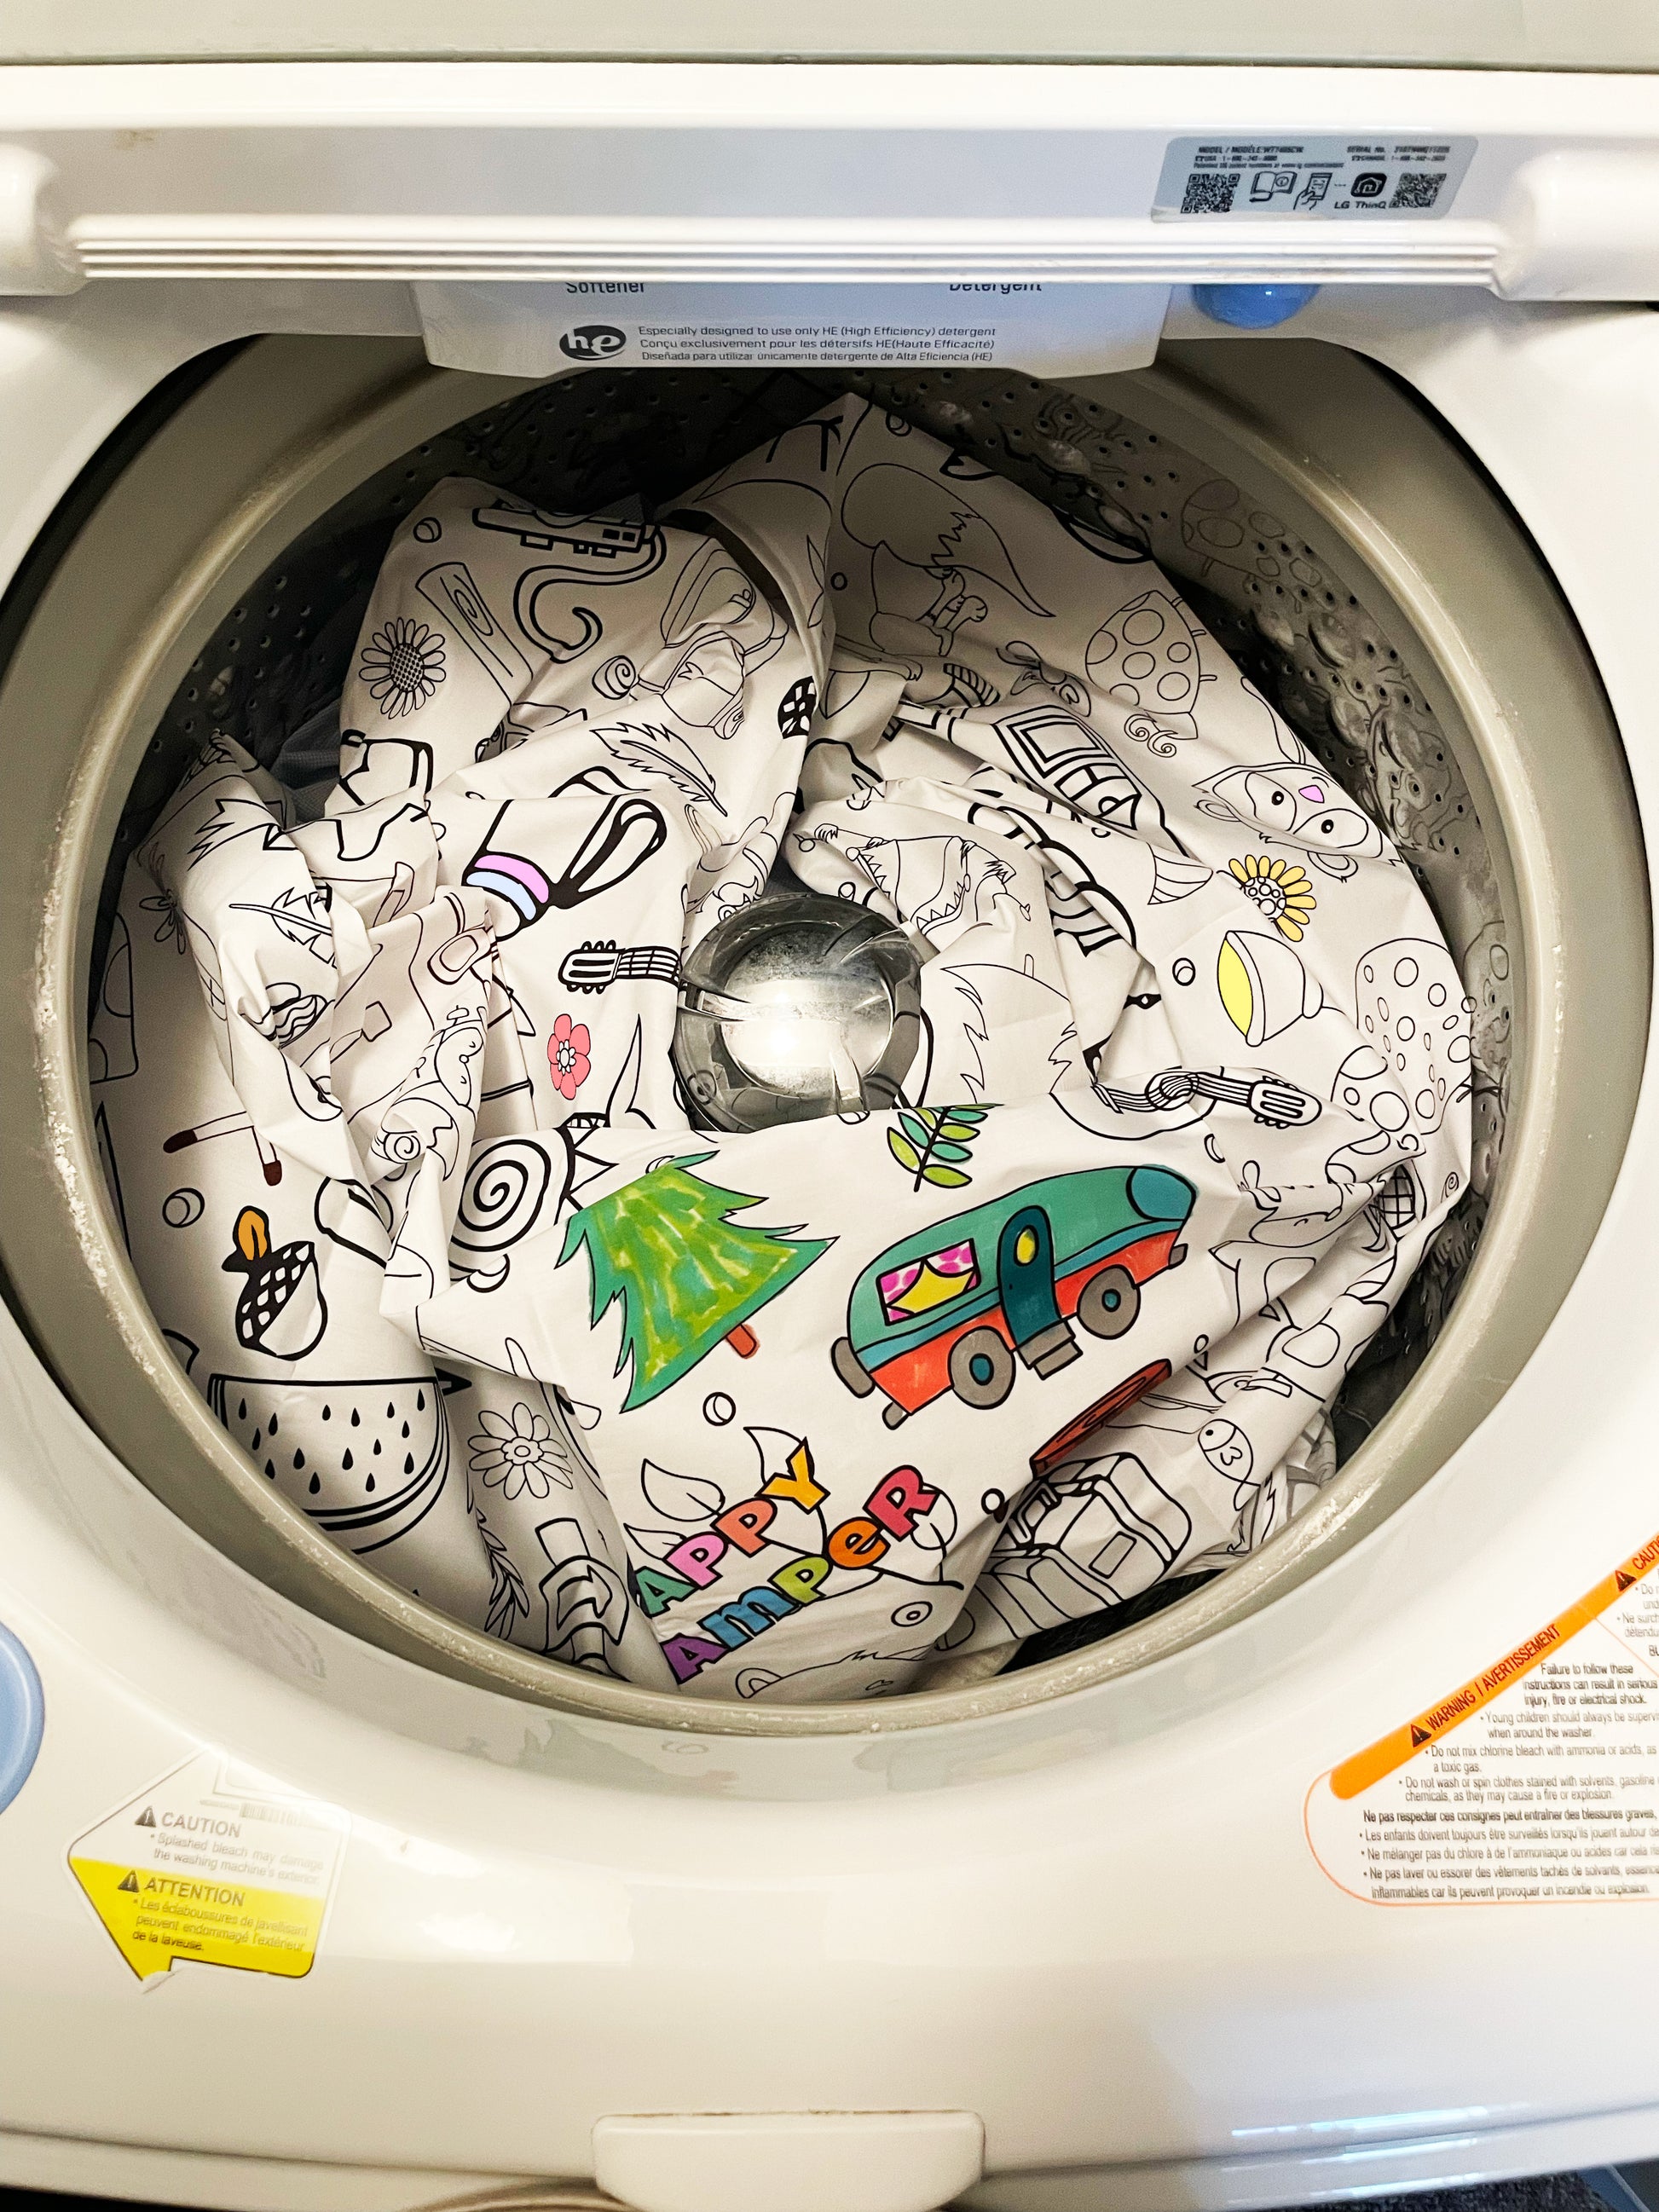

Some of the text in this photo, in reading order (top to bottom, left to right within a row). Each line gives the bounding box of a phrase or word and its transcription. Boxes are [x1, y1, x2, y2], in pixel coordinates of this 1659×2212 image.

[1334, 200, 1387, 210] LG ThinQ
[565, 282, 645, 293] Softener
[639, 326, 697, 337] Especially
[701, 326, 754, 337] designed
[795, 327, 820, 337] only
[823, 326, 838, 336] HE
[841, 326, 871, 337] (High
[874, 326, 936, 337] Efficiency)
[938, 327, 996, 338] detergent
[565, 326, 623, 356] he
[640, 339, 678, 349] Conçu
[680, 339, 766, 348] exclusivement
[770, 340, 797, 349] pour
[800, 339, 818, 348] les
[819, 339, 873, 349] détersifs
[934, 339, 995, 349] Efficacité)
[642, 351, 993, 362] Diseñada para utilizar únicamente detergente de Alta Eficiencia (HE)
[629, 1437, 830, 1618] APPY
[1425, 1623, 1561, 1731] WARNING AVERTISSEMENT
[1541, 1663, 1570, 1675] Failure
[1572, 1664, 1581, 1675] to
[1610, 1663, 1634, 1674] these
[1573, 1680, 1588, 1690] can
[1591, 1679, 1616, 1689] result
[1627, 1678, 1658, 1689] serious
[1579, 1693, 1617, 1705] electrical
[1485, 1709, 1625, 1725] Young children should always be
[1488, 1727, 1512, 1739] when
[1513, 1726, 1543, 1738] around
[1546, 1726, 1559, 1738] the
[1431, 1743, 1657, 1757] Do not mix chlorine bleach with ammonia as
[1441, 1760, 1482, 1776] toxic gas.
[1405, 1776, 1419, 1788] Do
[1420, 1776, 1435, 1788] not
[1436, 1776, 1460, 1788] wash
[1473, 1776, 1491, 1790] spin
[1493, 1776, 1524, 1788] clothes
[1526, 1775, 1558, 1788] stained
[1560, 1775, 1577, 1787] with
[1619, 1775, 1655, 1789] gasoline
[1454, 1792, 1464, 1802] as
[1465, 1789, 1484, 1804] they
[1487, 1792, 1506, 1804] may
[1508, 1791, 1534, 1801] cause
[1544, 1788, 1558, 1800] fire
[161, 1811, 243, 1838] CAUTION
[1363, 1807, 1657, 1825] Ne pas respecter ces consignes peut des blessures graves,
[1365, 1828, 1382, 1842] Les
[1384, 1828, 1416, 1842] enfants
[1419, 1828, 1450, 1841] doivent
[1452, 1828, 1487, 1844] toujours
[1591, 1827, 1617, 1841] jouent
[1620, 1828, 1647, 1839] autour
[157, 1833, 324, 1872] Splashed bleach may damage
[1367, 1848, 1380, 1861] Ne
[1425, 1849, 1442, 1862] pas
[1443, 1846, 1455, 1859] du
[1457, 1846, 1484, 1859] chlore
[1494, 1846, 1506, 1859] de
[1570, 1847, 1582, 1858] ou
[1584, 1845, 1612, 1857] acides
[1614, 1846, 1627, 1857] car
[153, 1847, 171, 1861] the
[174, 1853, 220, 1872] washing
[221, 1860, 275, 1878] machine's
[1369, 1867, 1383, 1880] Ne
[1384, 1868, 1402, 1882] pas
[1402, 1867, 1425, 1880] laver
[1427, 1869, 1439, 1880] ou
[1440, 1868, 1473, 1880] essorer
[1475, 1865, 1492, 1878] des
[1571, 1864, 1582, 1877] de
[144, 1877, 246, 1907] ATTENTION
[1371, 1883, 1605, 1900] inflammables car ils peuvent provoquer un incendie ou
[140, 1897, 160, 1911] Les
[240, 1915, 254, 1926] de
[136, 1915, 178, 1932] peuvent
[132, 1930, 204, 1952] de la laveuse.
